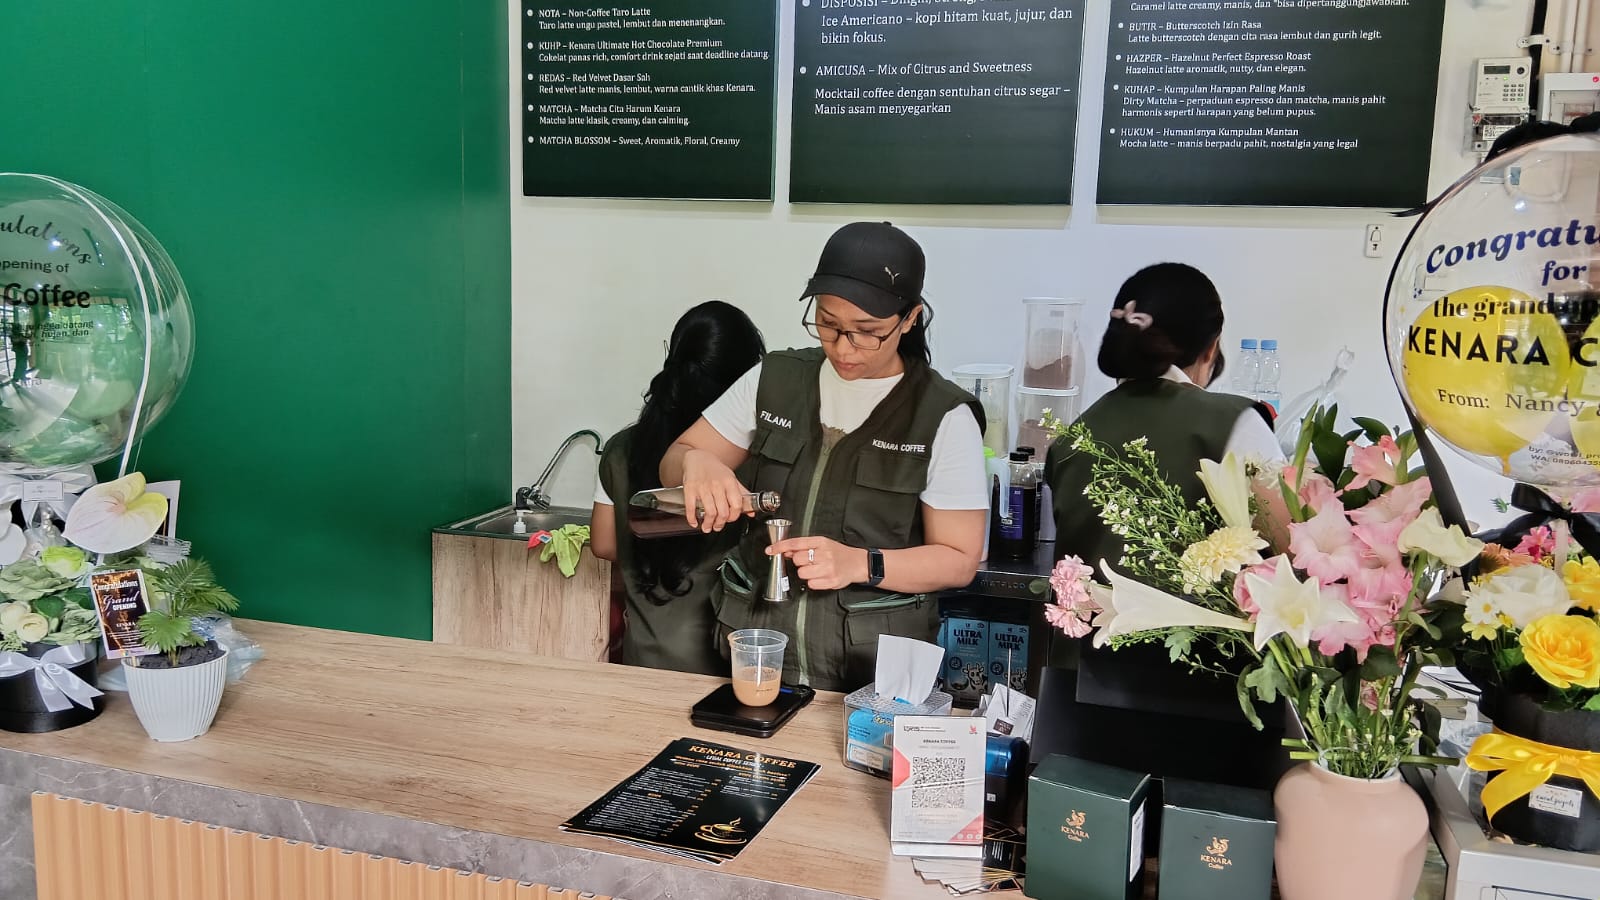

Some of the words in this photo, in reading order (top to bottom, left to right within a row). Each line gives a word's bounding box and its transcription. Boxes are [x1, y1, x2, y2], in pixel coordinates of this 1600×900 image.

[1167, 1, 1187, 10] latte
[539, 9, 560, 18] NOTA
[611, 7, 629, 16] Taro
[631, 7, 650, 16] Latte
[821, 15, 838, 26] Ice
[840, 14, 902, 26] Americano
[915, 11, 940, 25] kopi
[943, 11, 978, 22] hitam
[1049, 8, 1072, 19] dan
[538, 20, 556, 29] Taro
[557, 20, 574, 29] latte
[576, 22, 595, 31] ungu
[623, 18, 650, 28] lembut
[652, 18, 666, 27] dan
[1129, 22, 1157, 31] BUTIR
[1166, 20, 1220, 30] Butterscotch
[1241, 20, 1261, 29] Rasa
[821, 32, 849, 43] bikin
[853, 31, 886, 43] fokus.
[1128, 34, 1149, 42] Latte
[1151, 32, 1205, 42] butterscotch
[1207, 32, 1239, 42] dengan
[1241, 32, 1257, 40] cita
[1280, 30, 1312, 40] lembut
[1313, 30, 1330, 39] dan
[1332, 30, 1357, 41] gurih
[539, 41, 561, 50] KUHP
[569, 41, 595, 50] Kenara
[597, 40, 629, 49] Ultimate
[631, 40, 645, 49] Hot
[646, 39, 685, 48] Chocolate
[686, 38, 722, 47] Premium
[1126, 53, 1162, 62] HAZPER
[1171, 52, 1209, 62] Hazelnut
[1211, 52, 1242, 61] Perfect
[1244, 52, 1283, 62] Espresso
[1286, 51, 1311, 60] Roast
[815, 64, 866, 76] AMICUSA
[878, 64, 897, 75] Mix
[900, 63, 912, 74] of
[913, 63, 946, 74] Citrus
[948, 62, 969, 73] and
[972, 62, 1032, 72] Sweetness
[539, 73, 565, 82] REDAS
[572, 73, 587, 82] Red
[613, 73, 635, 82] Dasar
[815, 87, 860, 98] Mocktail
[862, 87, 894, 98] coffee
[897, 86, 936, 100] dengan
[939, 85, 990, 97] sentuhan
[994, 85, 1026, 96] citrus
[1029, 87, 1061, 98] segar
[1124, 85, 1155, 94] KUHAP
[1164, 84, 1207, 95] Kumpulan
[1210, 84, 1246, 94] Harapan
[1249, 84, 1276, 94] Paling
[1278, 84, 1305, 92] Manis
[1123, 97, 1144, 107] Dirty
[1146, 96, 1177, 104] Matcha
[1186, 95, 1233, 107] perpaduan
[1235, 97, 1274, 106] espresso
[1276, 95, 1292, 104] dan
[1332, 95, 1359, 104] manis
[1361, 94, 1386, 105] pahit
[539, 104, 572, 113] MATCHA
[580, 104, 607, 113] Matcha
[626, 104, 652, 112] Harum
[653, 104, 680, 112] Kenara
[814, 103, 845, 114] Manis
[848, 106, 875, 114] asam
[878, 102, 951, 116] menyegarkan
[1122, 108, 1162, 116] harmonis
[1195, 107, 1231, 118] harapan
[1232, 109, 1254, 118] yang
[1256, 106, 1284, 115] belum
[1120, 128, 1153, 136] HUKUM
[1218, 127, 1262, 138] Kumpulan
[1265, 127, 1298, 136] Mantan
[539, 136, 572, 144] MATCHA
[574, 136, 610, 144] BLOSSOM
[710, 136, 740, 147] Creamy
[1119, 139, 1147, 147] Mocha
[1149, 138, 1168, 147] latte
[1177, 139, 1203, 147] manis
[1205, 138, 1241, 149] berpadu
[1312, 141, 1335, 149] yang
[1336, 138, 1358, 149] legal
[0, 260, 53, 274] pening
[56, 263, 70, 273] of
[1541, 260, 1588, 287] for
[3, 282, 91, 309] Coffee
[1433, 297, 1468, 318] the
[1472, 292, 1555, 322] grand
[1408, 325, 1550, 366] KENARA
[1437, 388, 1490, 408] From:
[1505, 393, 1586, 417] Nancy
[760, 410, 792, 430] FILANA
[872, 438, 898, 452] KENARA
[900, 443, 926, 453] COFFEE
[953, 628, 983, 639] ULTRA
[995, 632, 1025, 644] ULTRA
[956, 637, 979, 646] MILK
[998, 641, 1021, 651] MILK
[688, 745, 741, 759] KENARA
[745, 753, 798, 769] COFFEE
[1061, 825, 1090, 840] KENARA
[1200, 854, 1233, 866] KENARA
